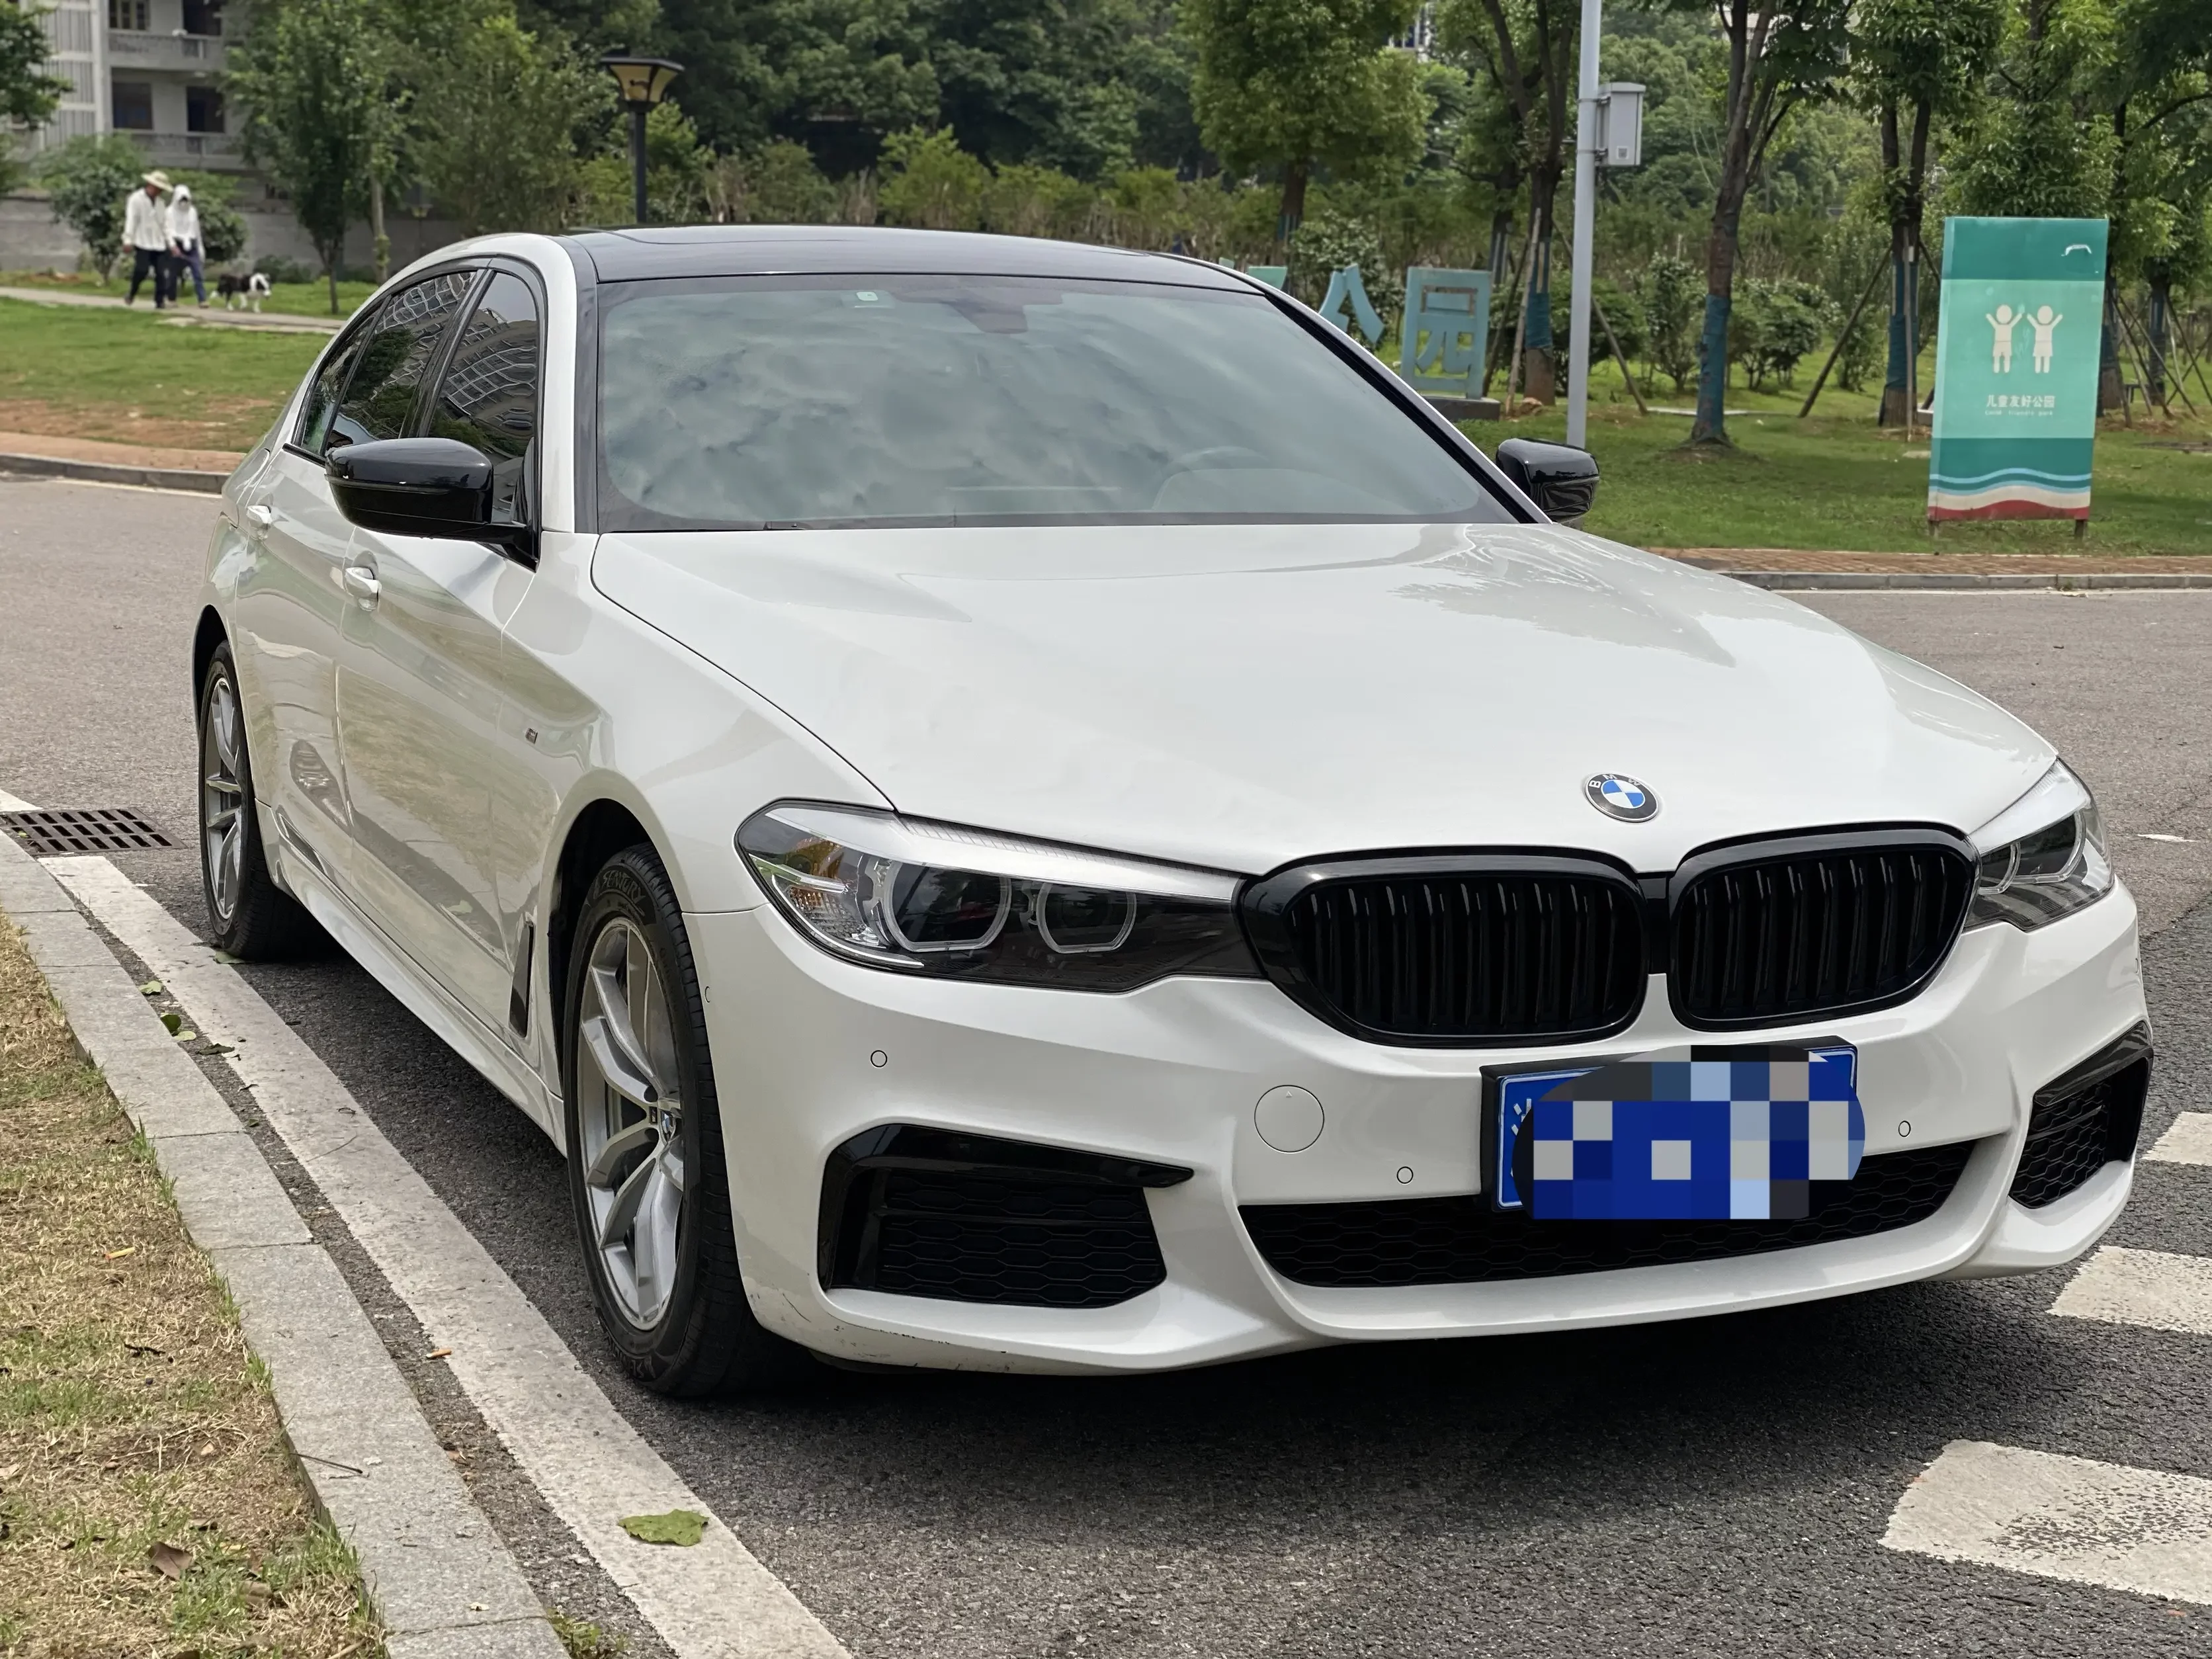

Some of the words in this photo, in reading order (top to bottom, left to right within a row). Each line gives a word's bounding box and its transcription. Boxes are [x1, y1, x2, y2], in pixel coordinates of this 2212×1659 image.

[1219, 257, 1492, 398] 公园
[1986, 394, 2055, 408] 儿童友好公园
[1588, 773, 1641, 788] BMW
